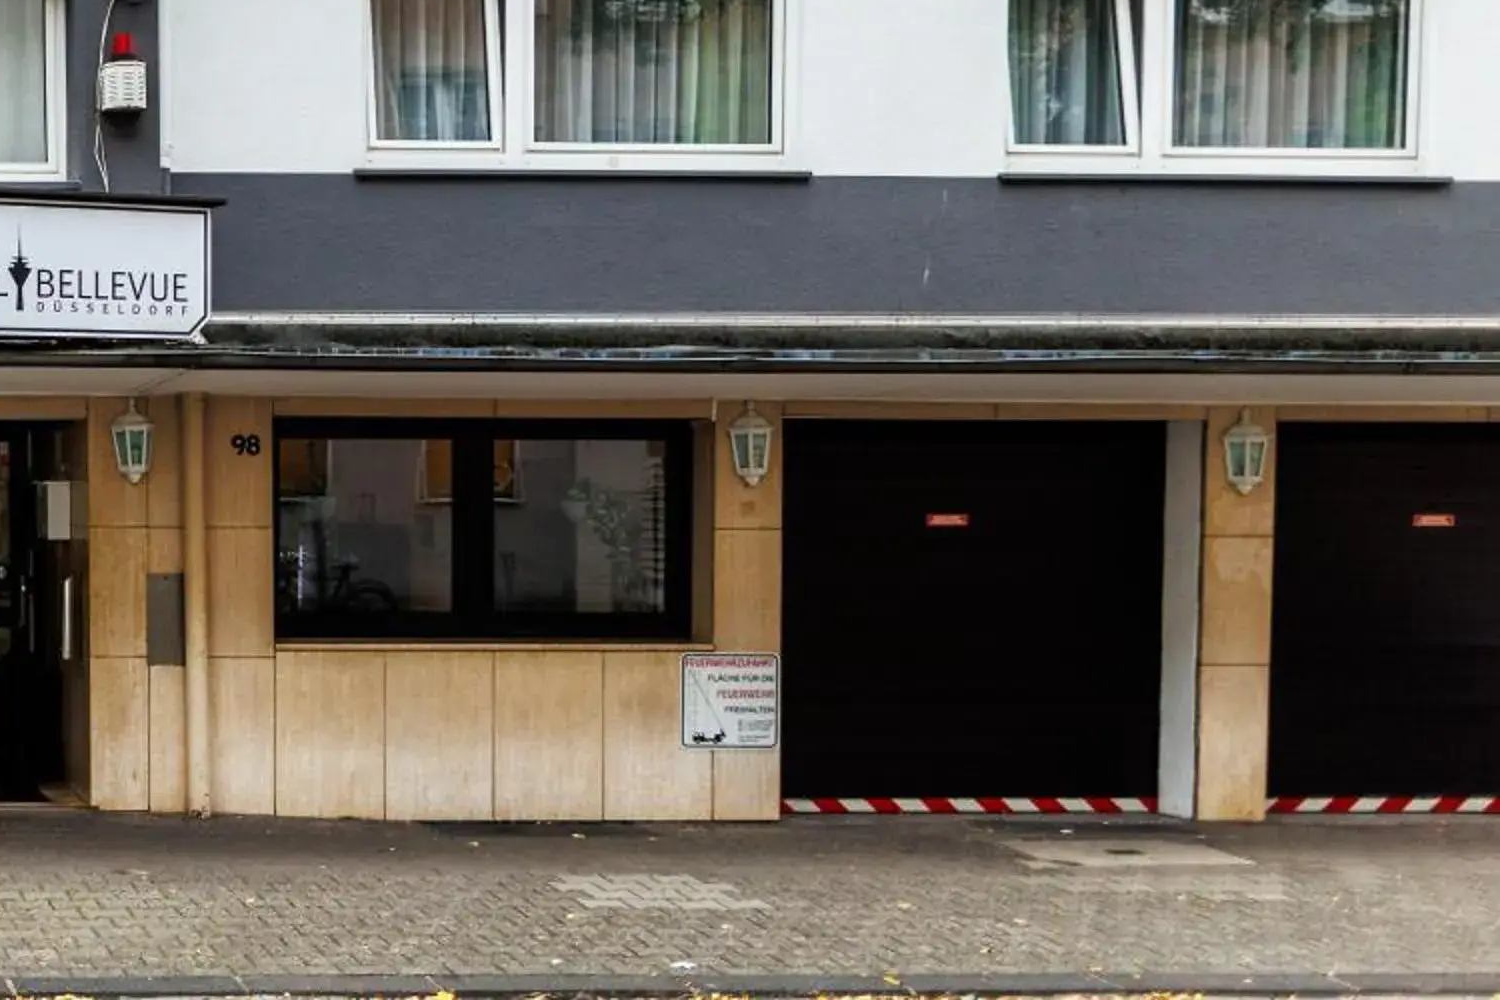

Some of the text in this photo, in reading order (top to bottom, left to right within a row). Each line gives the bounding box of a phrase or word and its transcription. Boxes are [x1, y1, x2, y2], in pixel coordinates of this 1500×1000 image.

[36, 268, 189, 303] BELLEVUE
[36, 300, 190, 317] DÜSSELDORF
[231, 434, 260, 456] 98
[716, 689, 775, 699] FEUERWEHR
